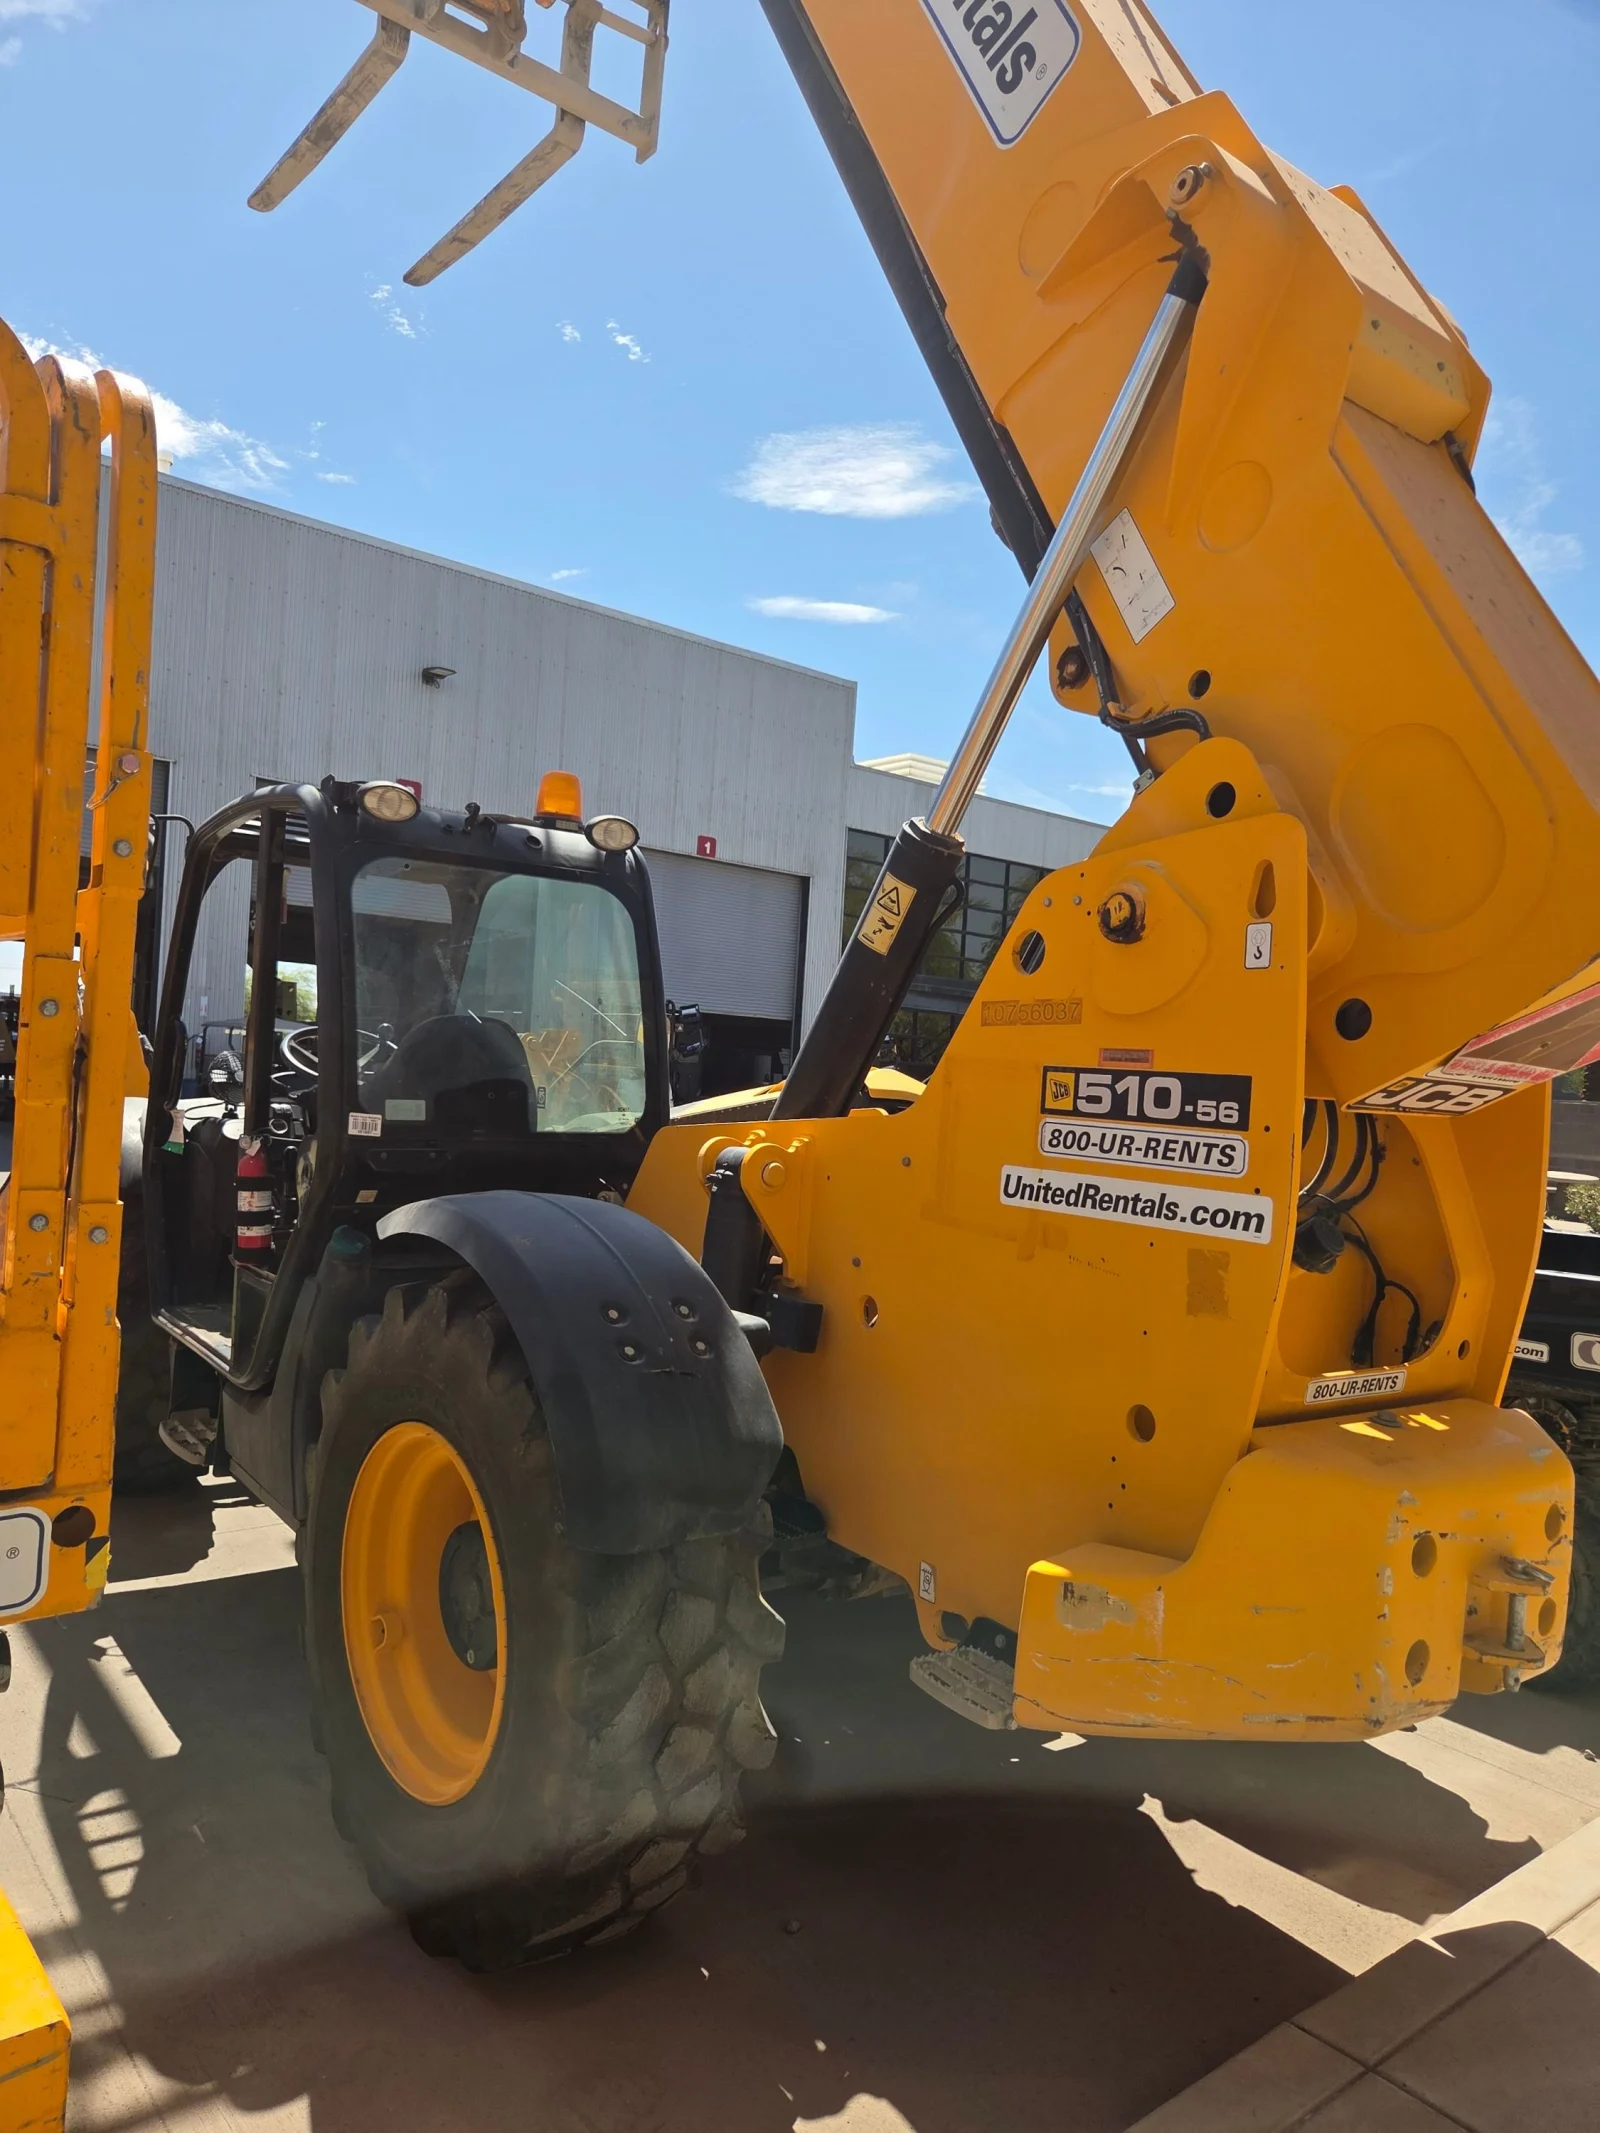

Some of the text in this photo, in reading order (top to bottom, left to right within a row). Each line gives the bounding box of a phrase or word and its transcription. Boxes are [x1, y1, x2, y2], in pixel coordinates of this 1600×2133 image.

[953, 0, 1038, 94] tals
[704, 841, 711, 855] 1
[1053, 1082, 1069, 1100] JCB
[1364, 1081, 1504, 1113] JCB
[1048, 1128, 1237, 1168] 800-UR-RENTS
[1002, 1174, 1265, 1234] UnitedRentals.com
[1313, 1375, 1399, 1400] 800-UR-RENTS
